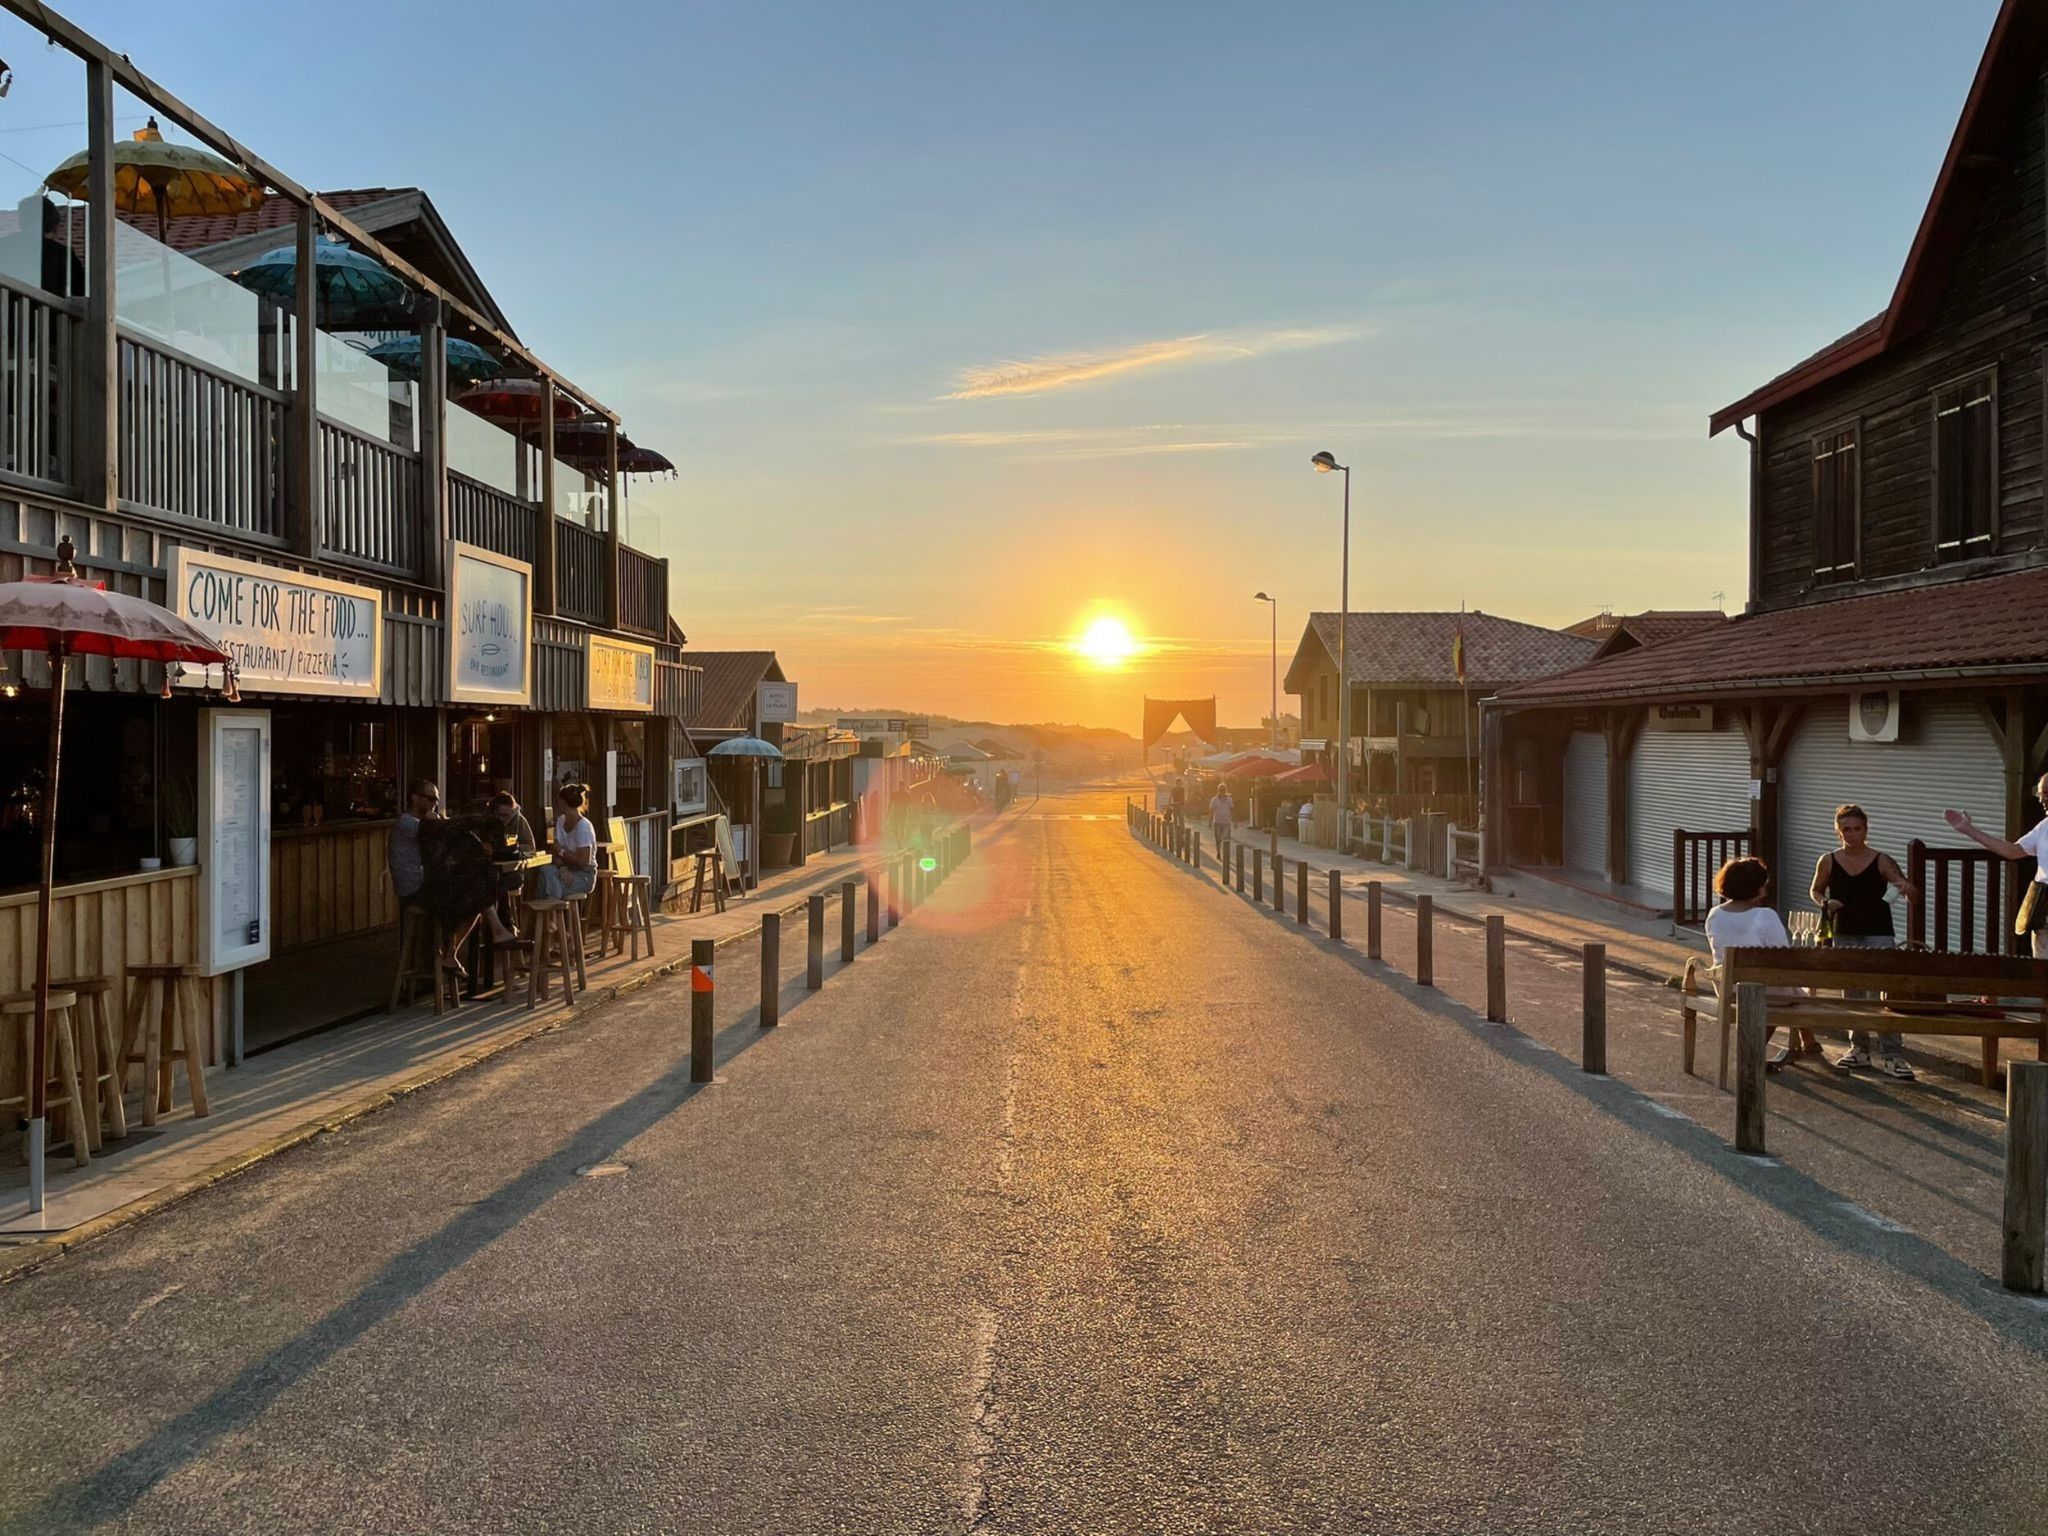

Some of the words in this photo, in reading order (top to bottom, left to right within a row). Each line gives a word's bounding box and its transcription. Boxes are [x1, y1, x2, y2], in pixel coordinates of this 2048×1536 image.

[188, 571, 243, 626] COME
[252, 583, 280, 632] FOR
[287, 589, 316, 635] THE
[461, 600, 487, 635] SURF
[490, 604, 518, 643] HOUSE
[470, 657, 480, 673] BAR
